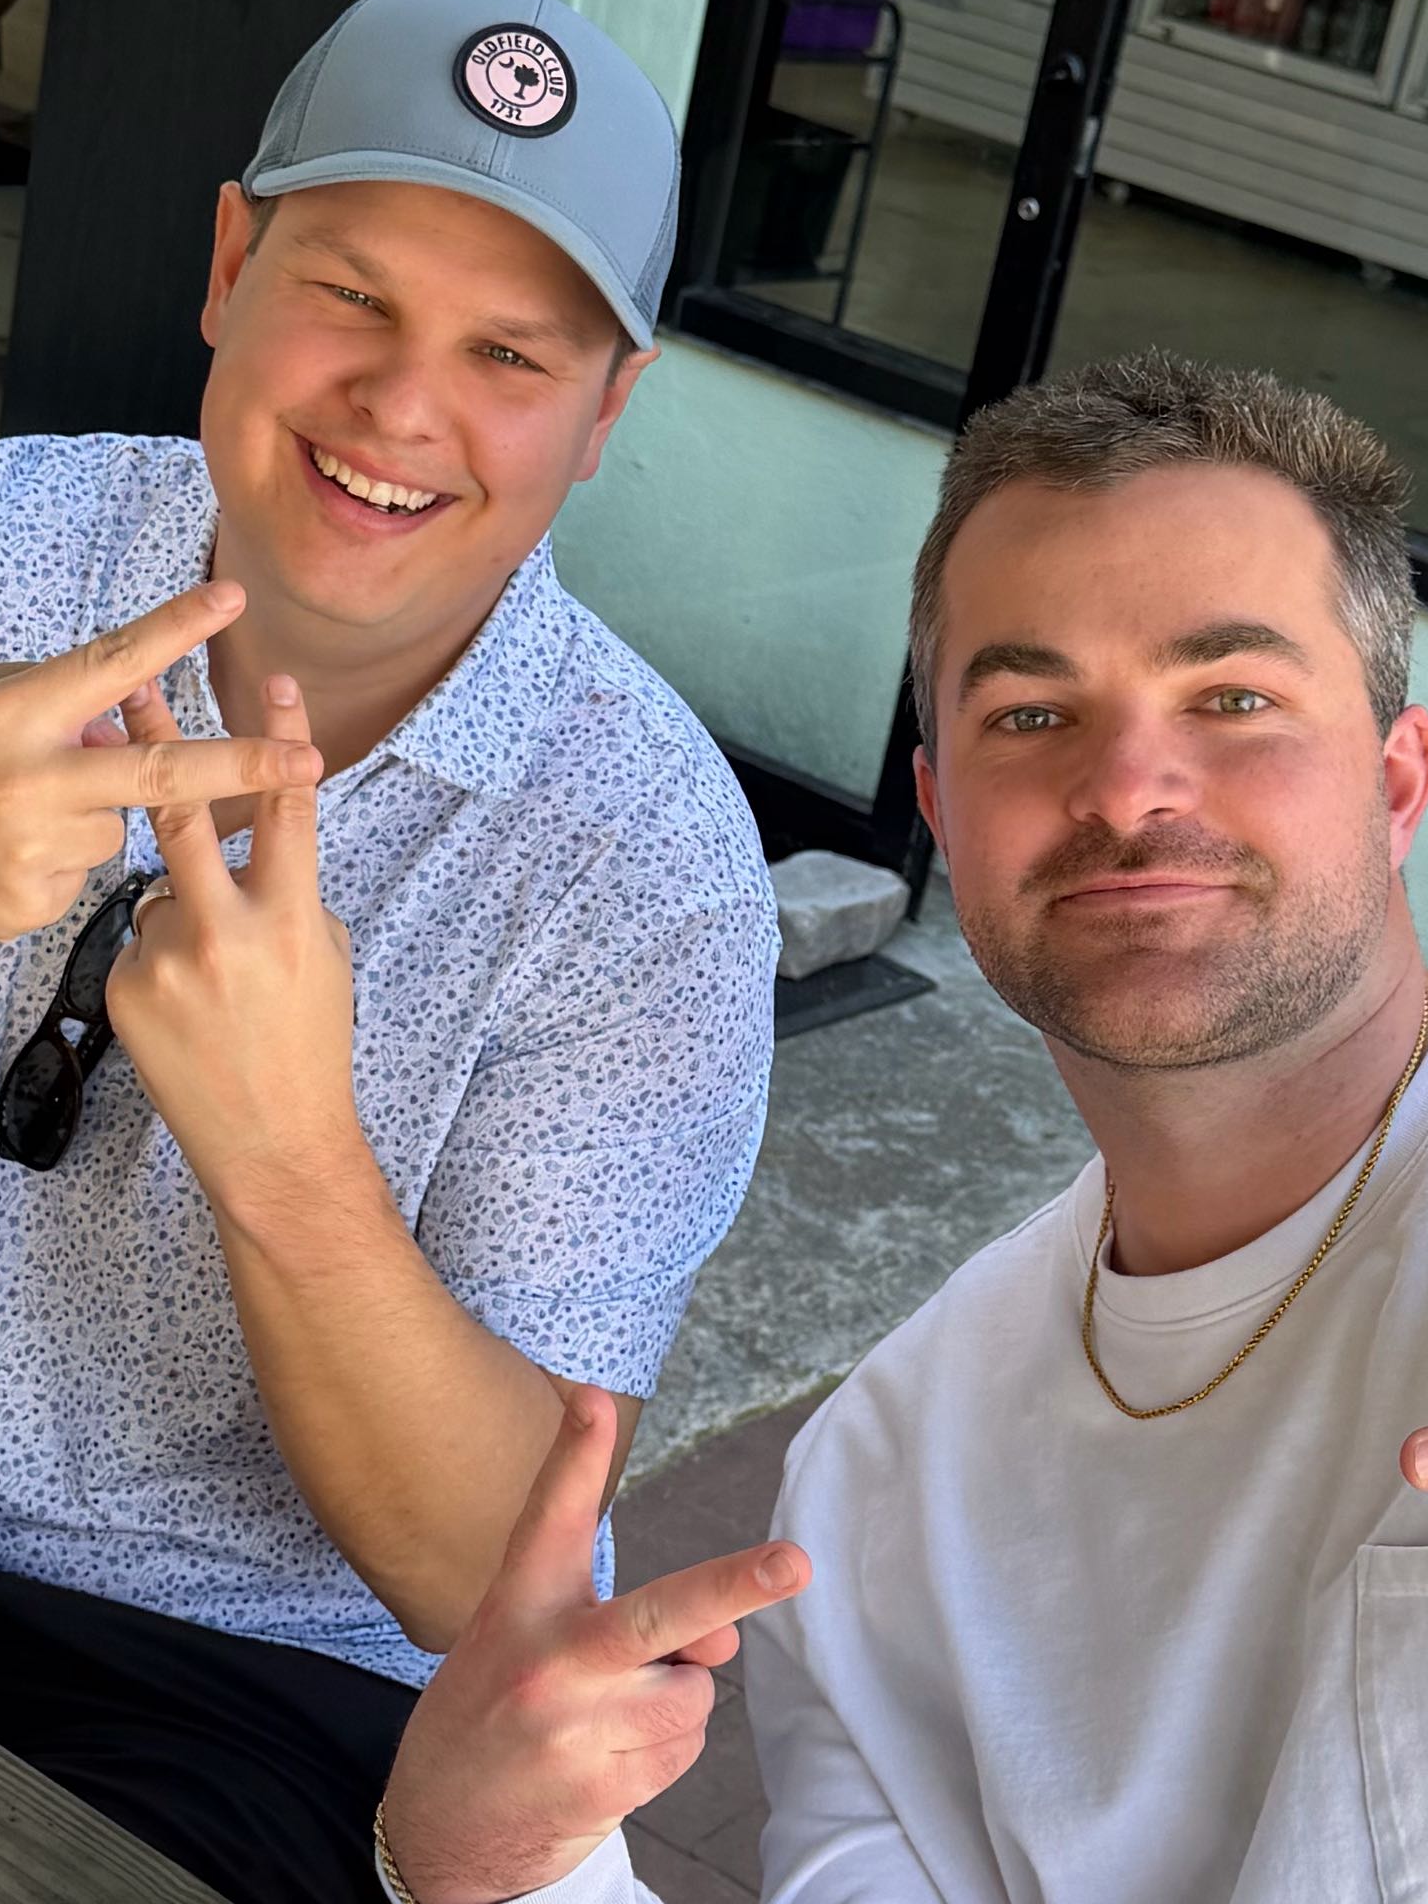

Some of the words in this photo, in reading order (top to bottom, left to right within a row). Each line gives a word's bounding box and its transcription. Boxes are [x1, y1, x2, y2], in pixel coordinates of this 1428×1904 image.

[471, 34, 545, 65] OLDFIELD
[544, 57, 565, 98] CLUB
[490, 98, 523, 121] 1732
